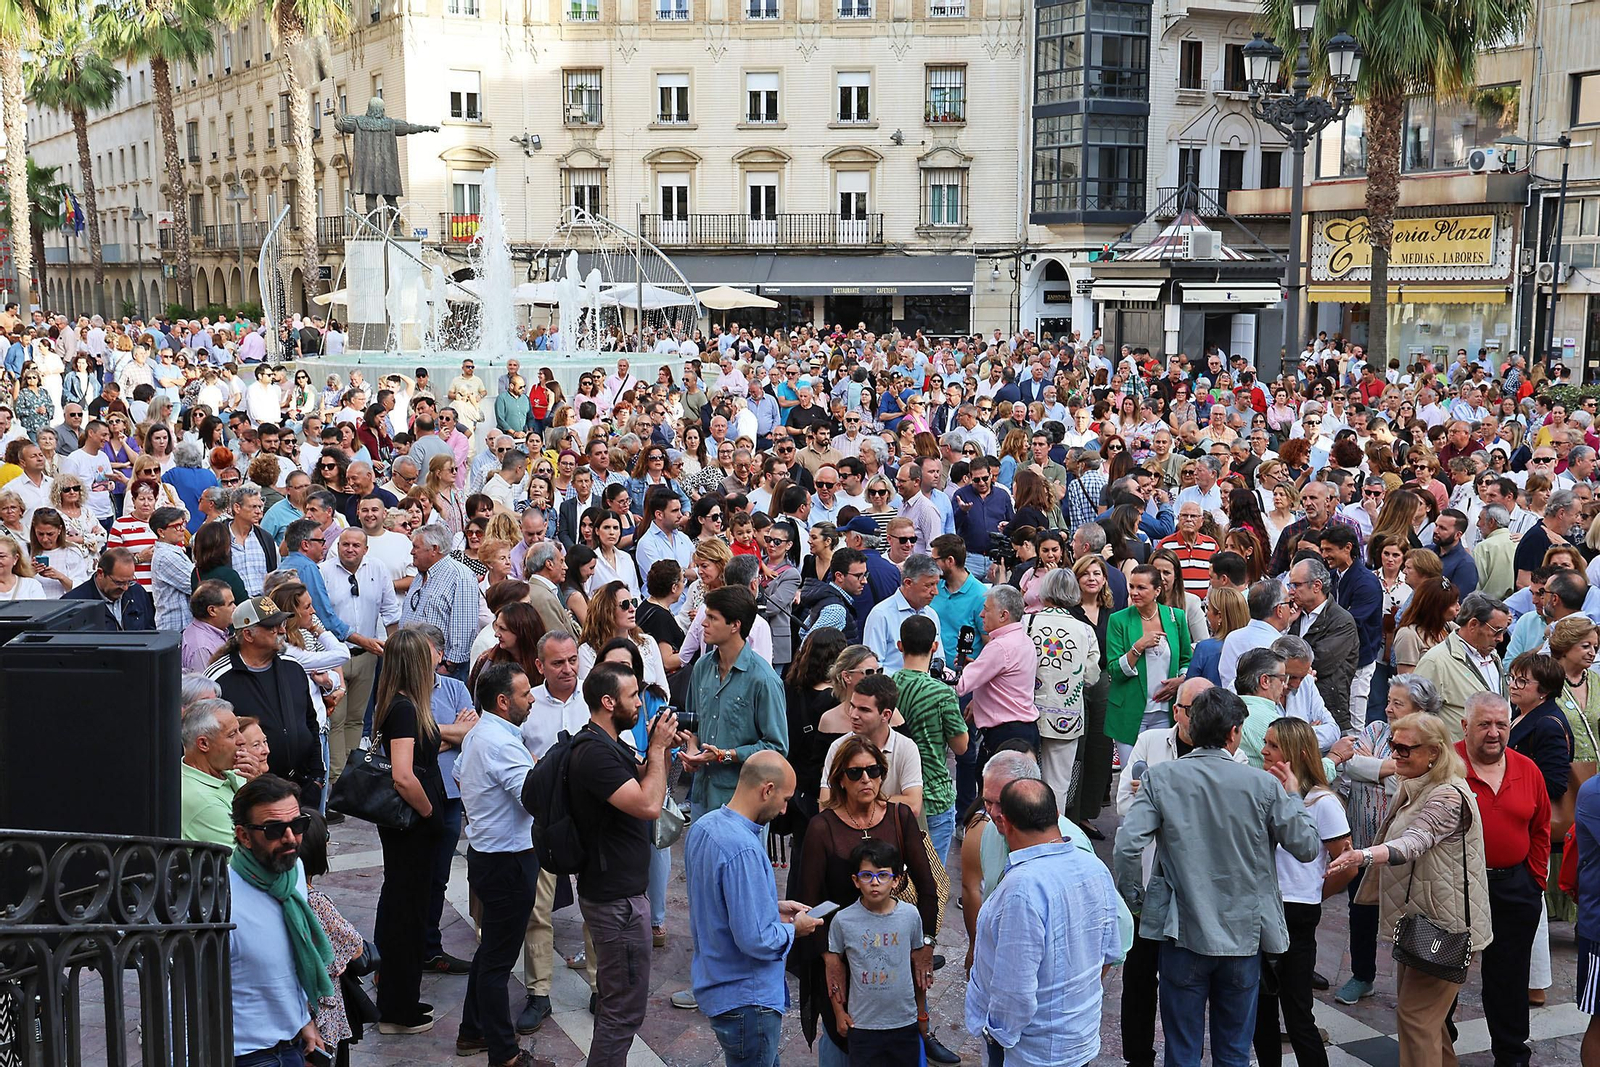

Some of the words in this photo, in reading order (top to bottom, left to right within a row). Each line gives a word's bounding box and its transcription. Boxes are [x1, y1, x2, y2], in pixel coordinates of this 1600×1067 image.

[1431, 219, 1492, 242] Plaza
[1401, 253, 1435, 264] MEDIAS
[1443, 251, 1484, 264] LABORES
